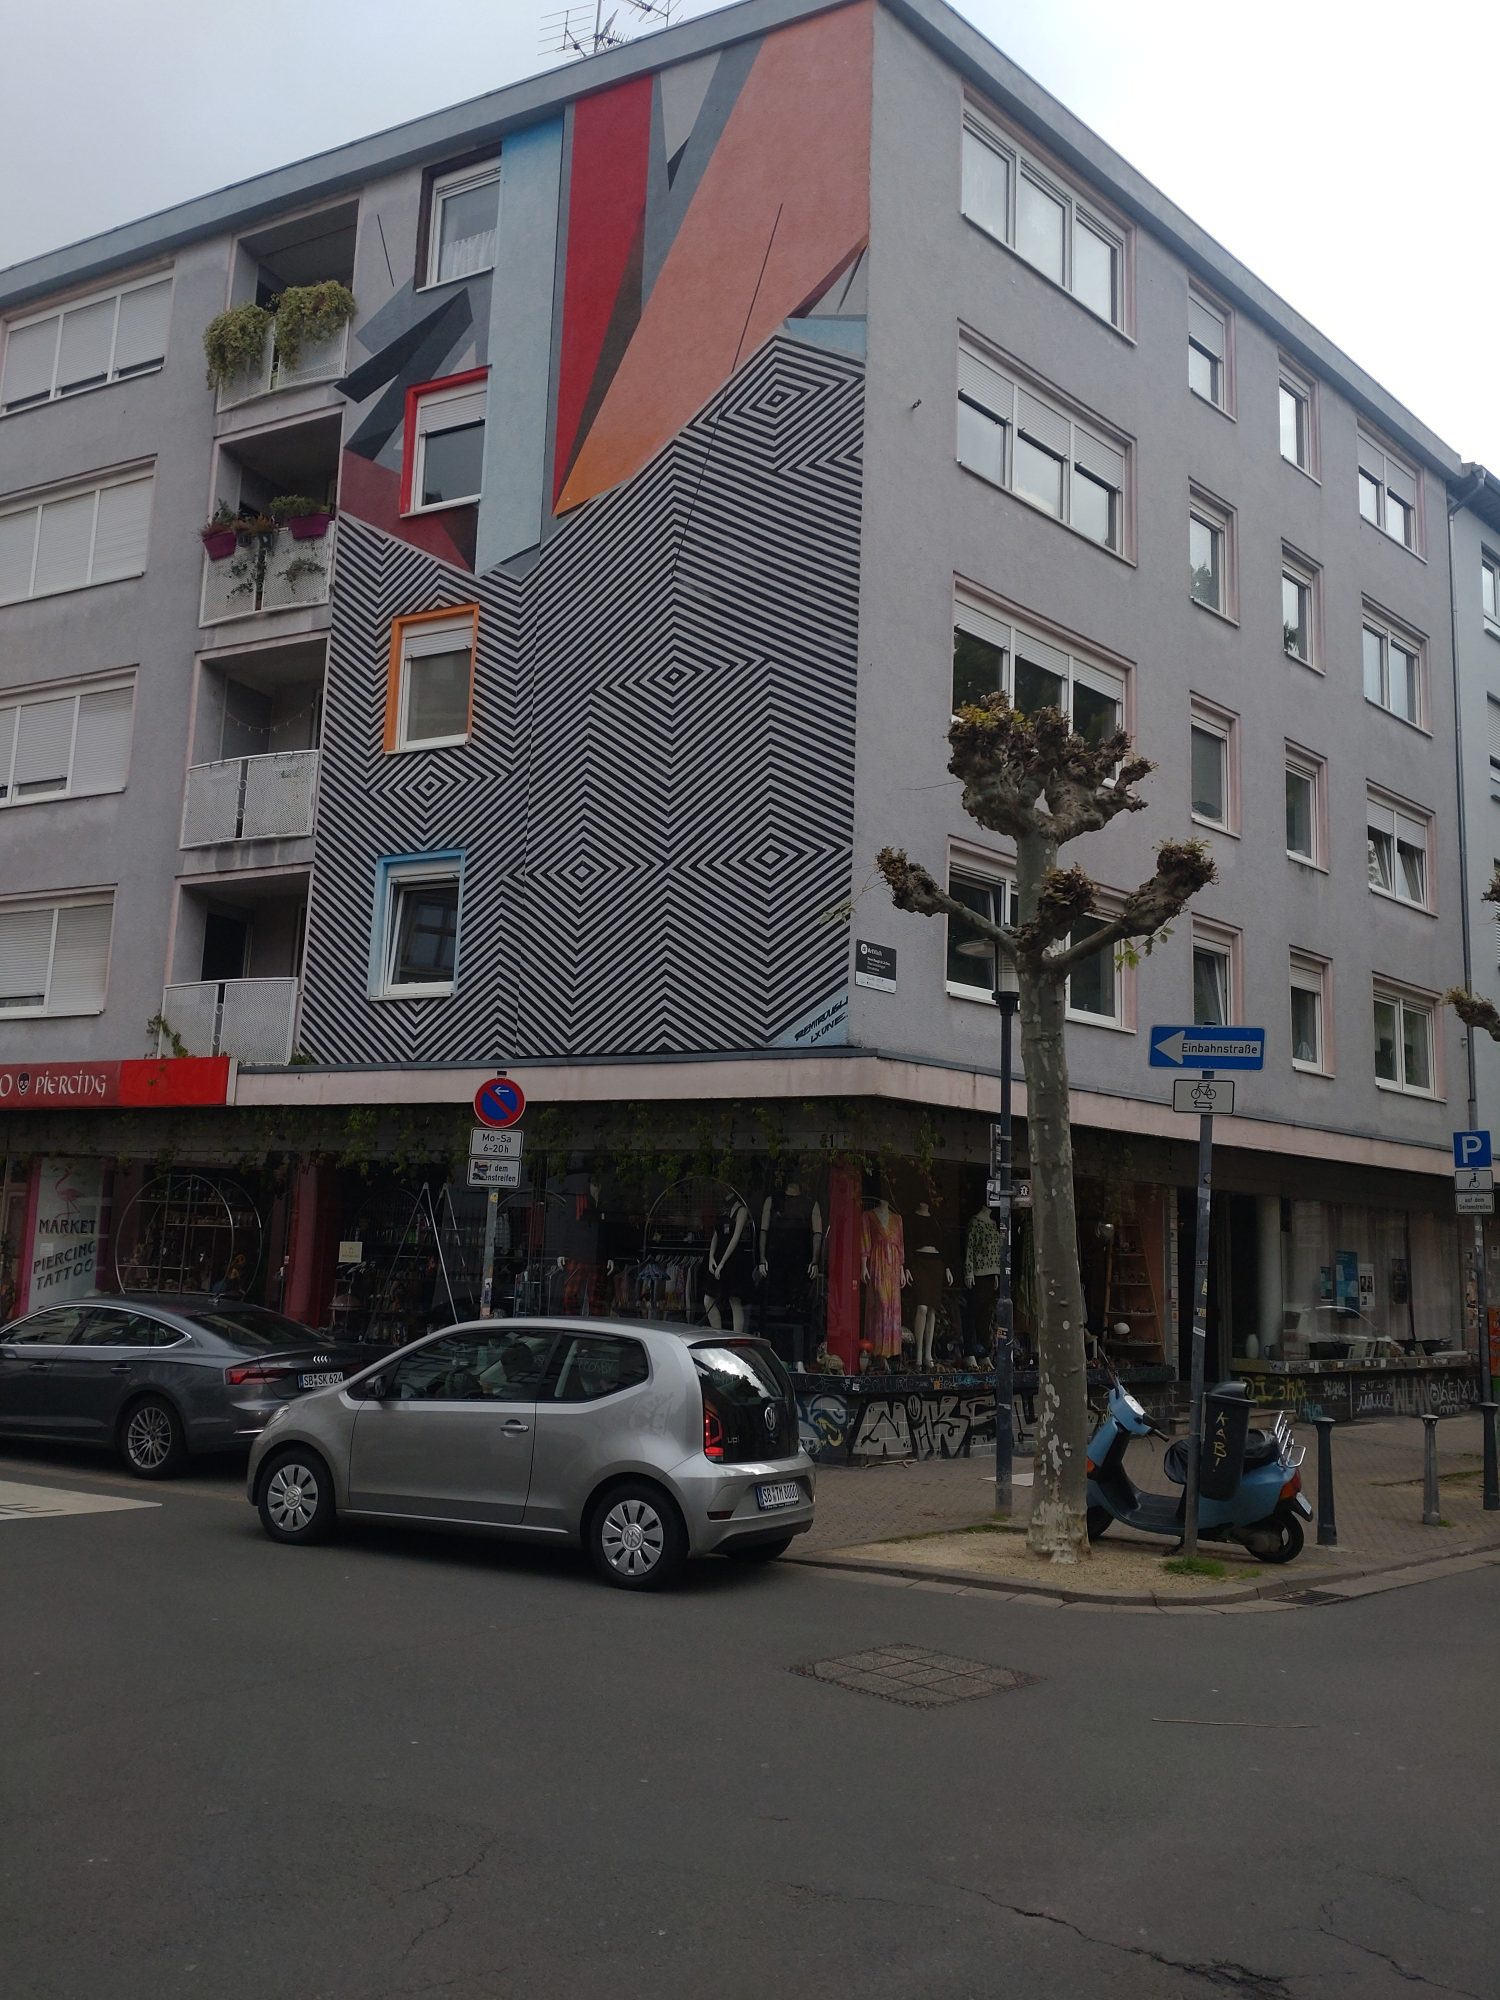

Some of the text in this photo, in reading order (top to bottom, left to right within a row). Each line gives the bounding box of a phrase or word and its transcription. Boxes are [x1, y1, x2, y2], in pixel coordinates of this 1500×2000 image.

[1182, 1043, 1257, 1054] Einbahnstraße
[1461, 1136, 1482, 1164] P
[494, 1164, 509, 1172] dem
[38, 1219, 97, 1235] MARKET
[33, 1240, 97, 1275] PIERCING
[36, 1258, 95, 1291] TATTOO
[303, 1375, 313, 1386] SB
[318, 1373, 328, 1385] SK
[762, 1487, 773, 1503] SB
